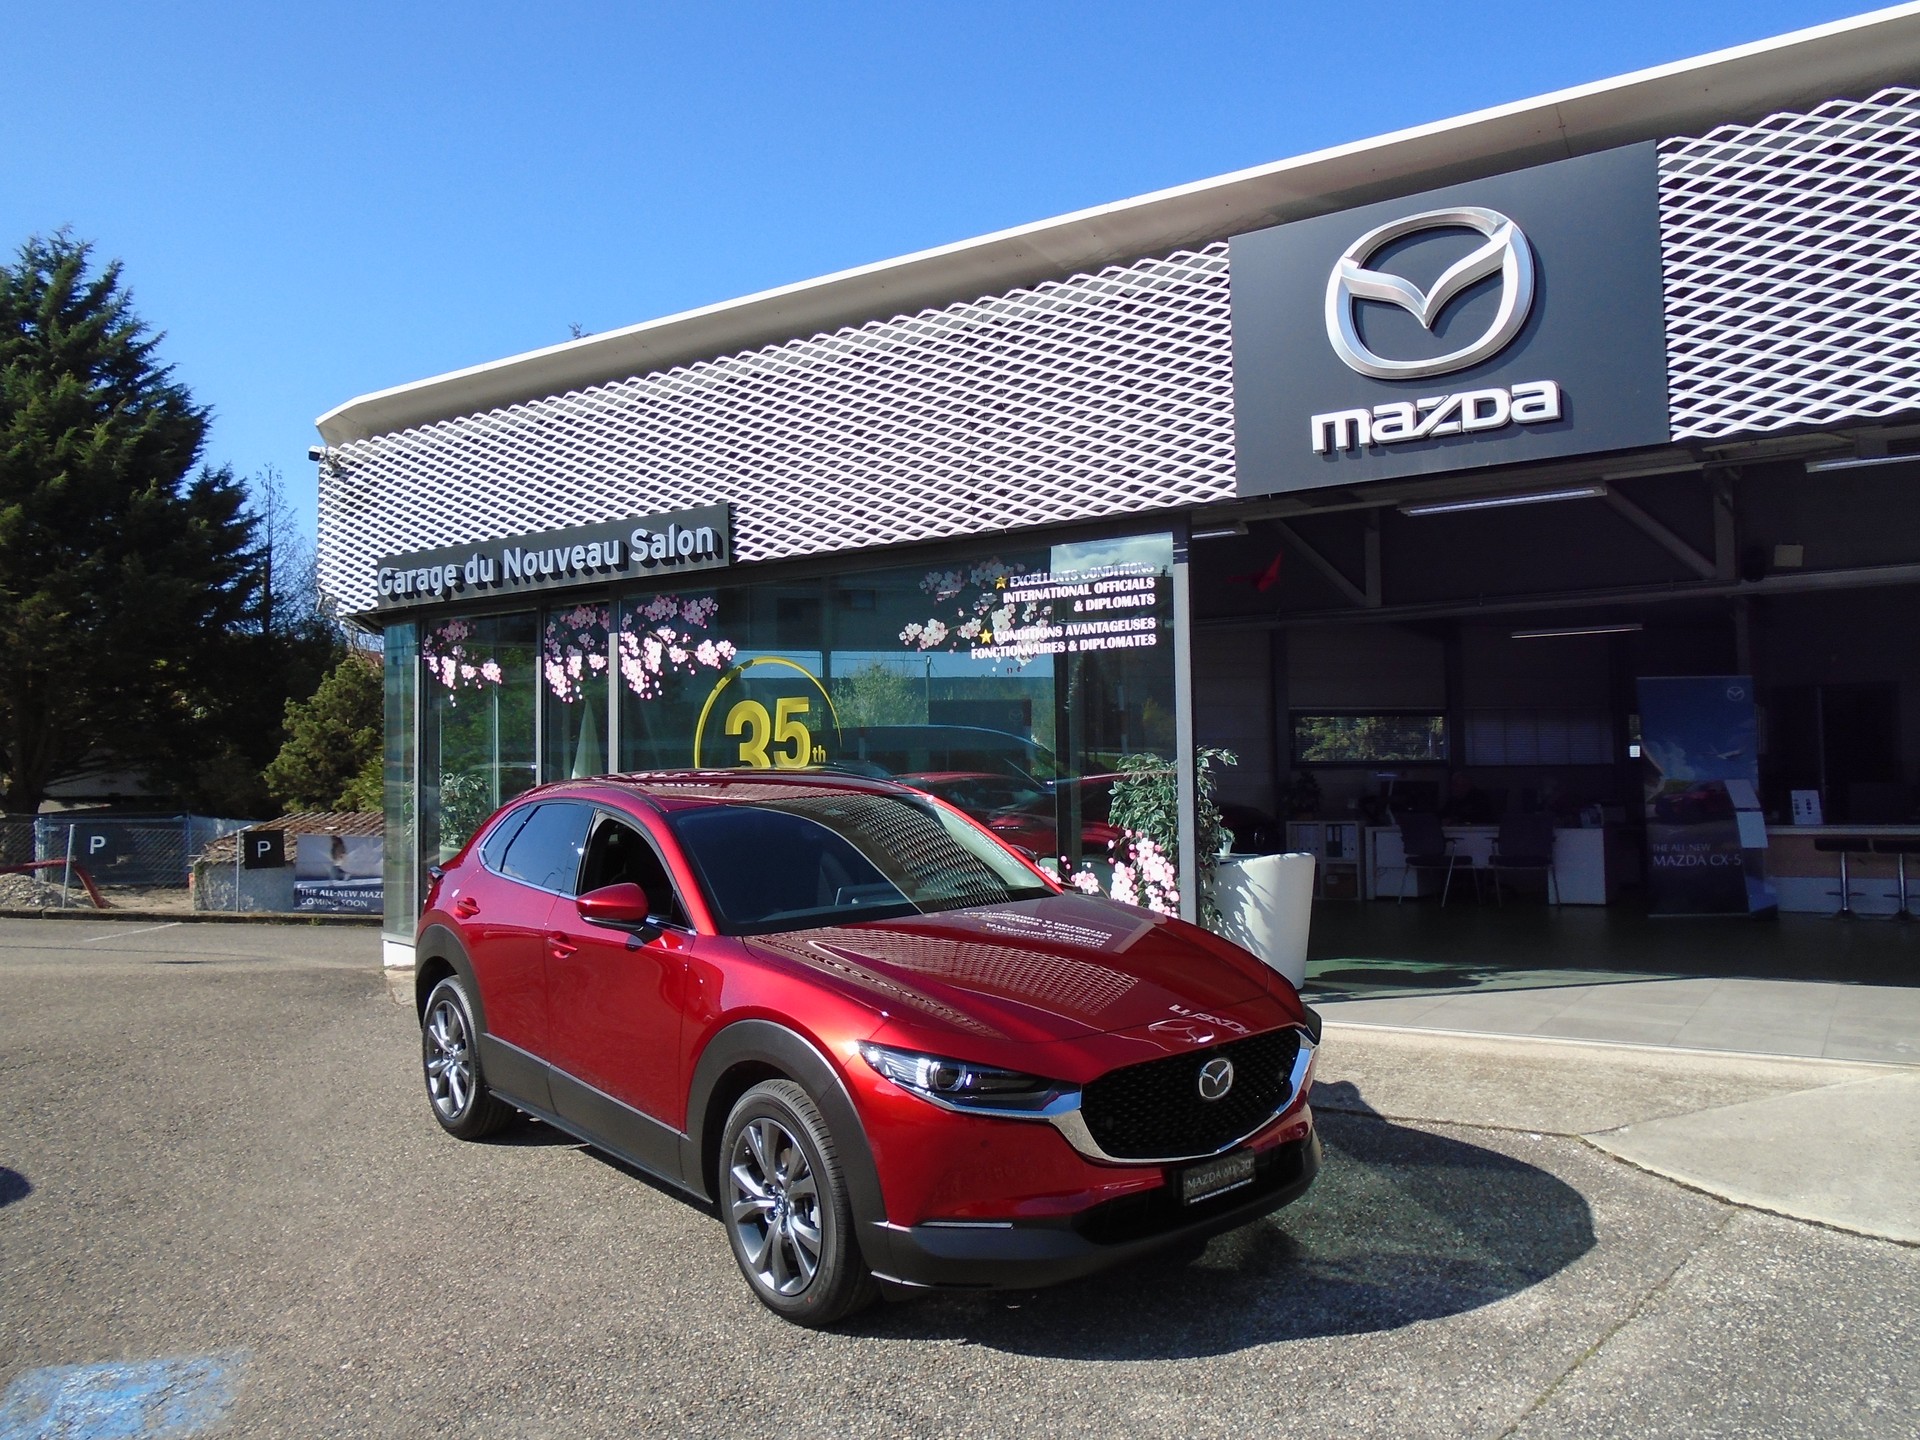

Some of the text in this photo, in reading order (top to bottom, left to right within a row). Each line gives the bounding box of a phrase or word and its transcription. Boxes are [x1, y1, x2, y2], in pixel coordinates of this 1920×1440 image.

[377, 523, 714, 597] Garage du Nouveau Salon
[1010, 562, 1155, 588] EXCELLENTS CONDITIONS
[1003, 577, 1156, 604] INTERNATIONAL OFFICIALS
[1074, 594, 1156, 612] & DIPLOMATS
[993, 617, 1157, 643] CONDITIONS AVANTAGEUSES
[971, 633, 1157, 660] FONCTIONNAIRES & DIPLOMATES
[89, 836, 107, 854] P
[257, 840, 271, 858] P
[1653, 843, 1668, 852] THE
[1653, 854, 1742, 867] MAZDA CX-5
[301, 888, 317, 896] THE
[320, 889, 358, 898] ALL-NEW
[301, 898, 368, 907] COMING SOON
[1187, 1170, 1222, 1189] MAZDA
